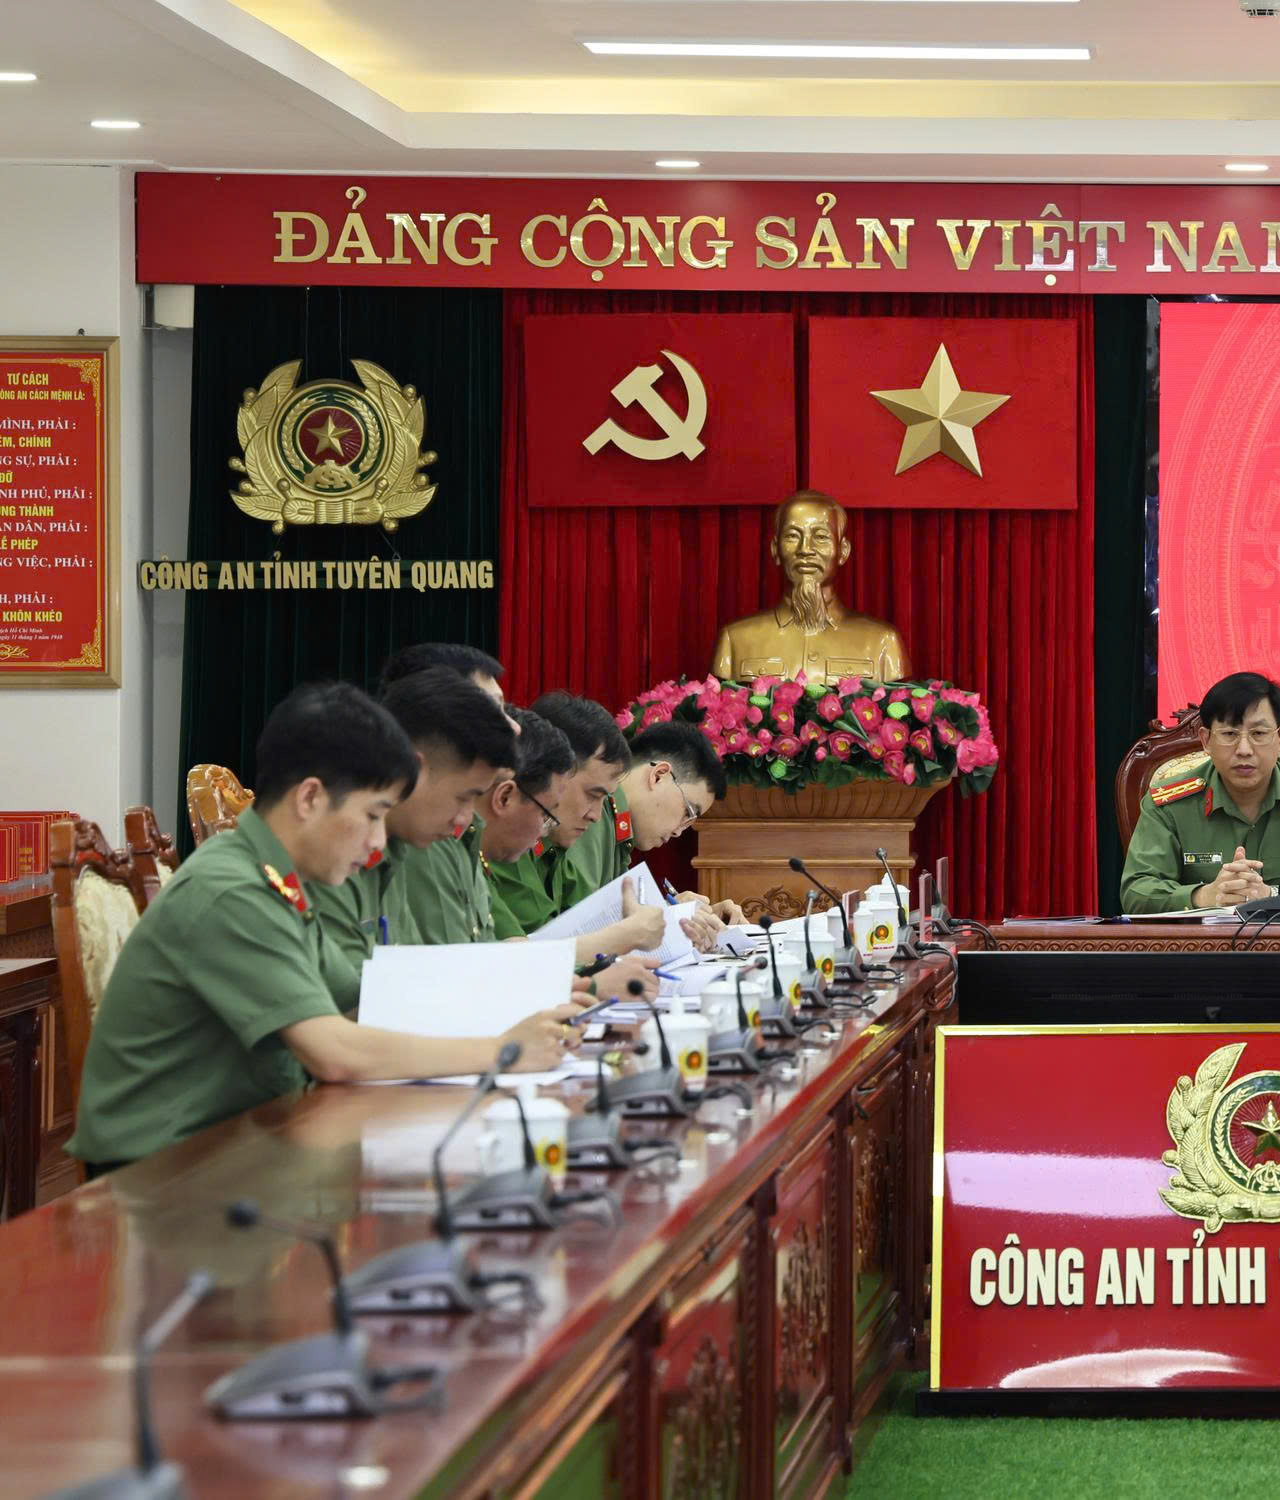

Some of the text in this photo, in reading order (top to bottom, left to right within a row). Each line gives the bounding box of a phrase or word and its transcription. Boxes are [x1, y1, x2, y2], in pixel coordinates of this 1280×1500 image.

[272, 186, 498, 266] ĐẢNG
[520, 197, 735, 282] CỘNG
[755, 191, 915, 271] SẢN
[936, 202, 1126, 286] VIỆT
[7, 371, 49, 385] TƯ CÁCH
[17, 390, 27, 400] AN
[38, 416, 69, 430] PHẢI
[18, 434, 52, 448] CHÍNH
[38, 453, 70, 466] PHẢI
[54, 486, 85, 499] PHẢI
[19, 503, 54, 517] THÀNH
[49, 519, 80, 532] PHẢI
[10, 537, 39, 550] PHÉP
[16, 554, 52, 570] VIỆC,
[54, 554, 86, 568] PHẢI
[140, 551, 494, 592] CÔNG AN TỈNH TUYÊN QUANG
[14, 591, 46, 604] PHẢI
[3, 608, 63, 622] KHÔN KHÉO
[970, 1234, 1083, 1306] CÔNG
[1096, 1247, 1154, 1305] AN
[1167, 1229, 1266, 1306] TỈNH
